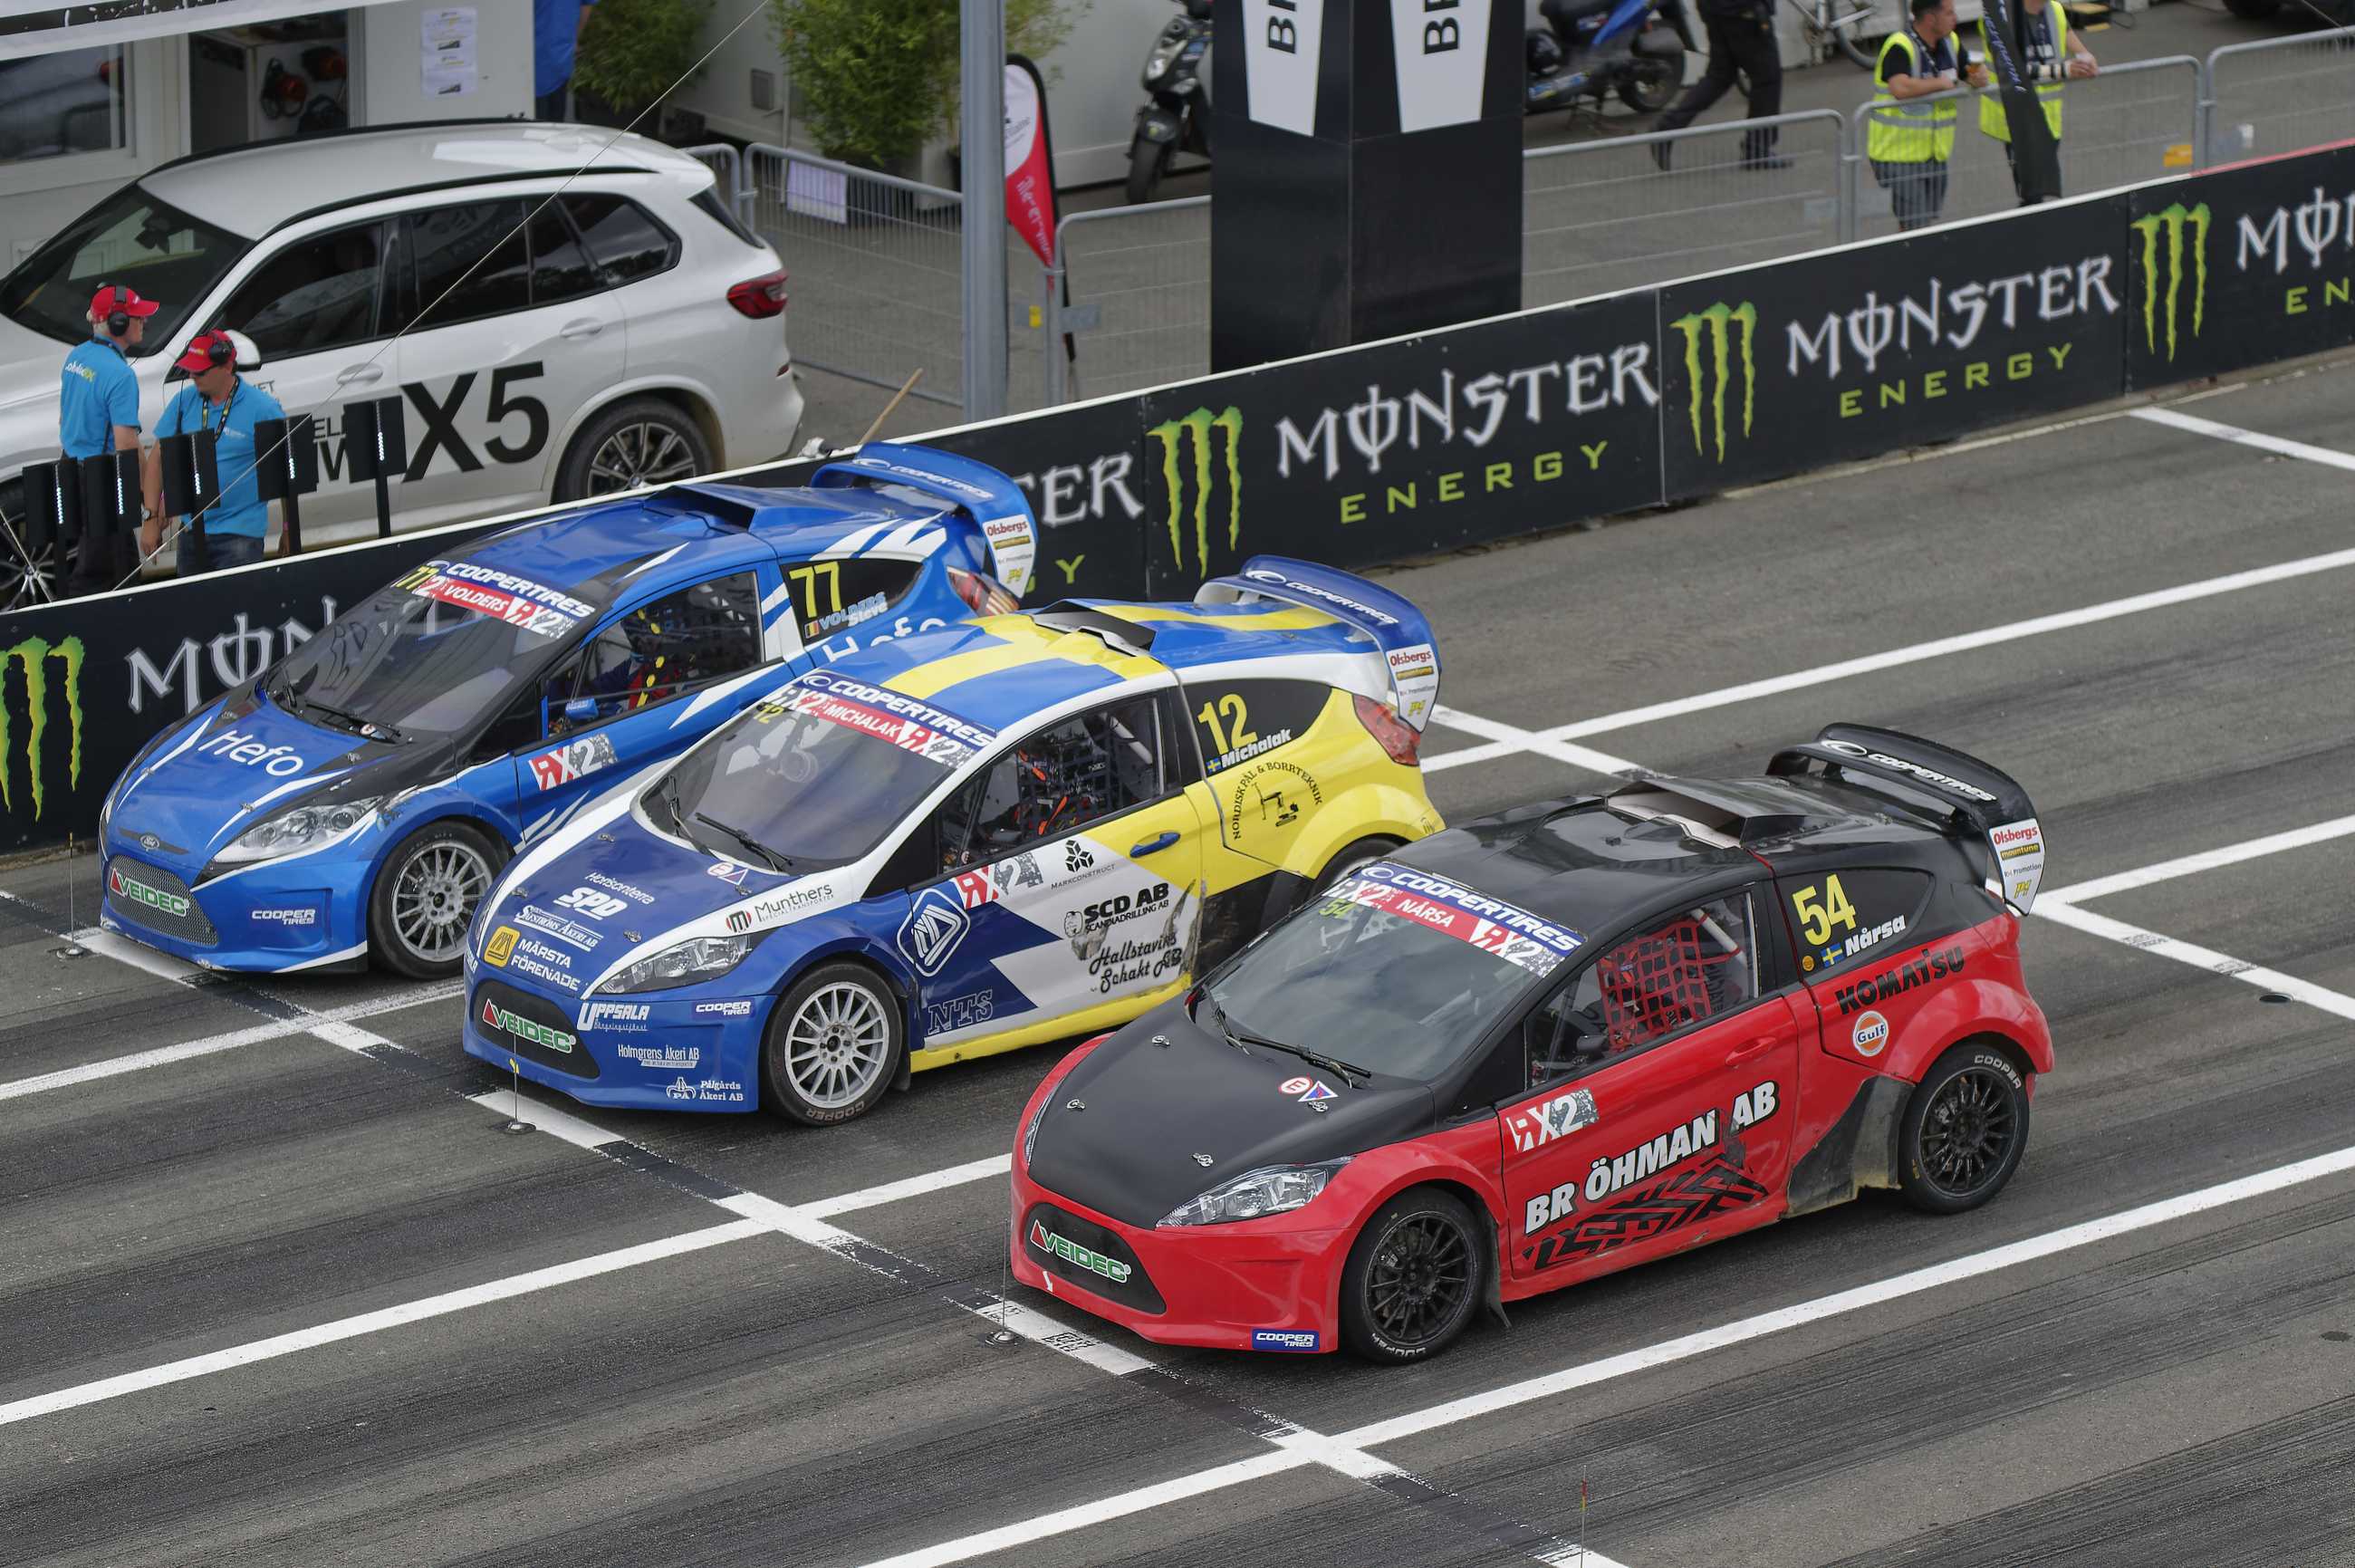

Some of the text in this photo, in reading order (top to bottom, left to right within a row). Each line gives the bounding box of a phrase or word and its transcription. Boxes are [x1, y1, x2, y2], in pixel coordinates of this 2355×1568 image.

[1786, 255, 2120, 380] MONSTER
[1840, 343, 2072, 418] ENERGY
[400, 361, 550, 484] X5
[1275, 341, 1659, 480] MONSTER
[1340, 440, 1608, 524] ENERGY
[987, 520, 1028, 537] Olsbergs
[393, 565, 440, 591] 77
[444, 583, 509, 611] VOLDERS
[789, 561, 842, 618] 77
[1390, 649, 1432, 668] Olsbergs
[825, 703, 902, 739] MICHALAK
[1197, 694, 1258, 755] 12
[197, 730, 303, 776] Hefo
[529, 739, 605, 791] RX2
[1221, 729, 1292, 767] Michalak
[1256, 765, 1264, 774] &
[1266, 761, 1322, 805] BORRTEKNIK
[1994, 825, 2038, 846] Olsbergs
[119, 876, 189, 917] VEIDEC
[558, 887, 629, 918] SPD
[755, 884, 832, 922] Munthers
[949, 858, 1030, 910] RX2
[1085, 882, 1169, 924] SCD AB
[252, 909, 316, 921] COOPER
[283, 917, 315, 926] TIRES
[1156, 900, 1169, 914] AB
[1793, 873, 1856, 946] 54
[518, 938, 572, 969] MÄRSTA
[1845, 914, 1906, 957] Nårsa
[511, 956, 581, 991] FÖRENADE
[1101, 958, 1150, 993] Schakt
[1835, 946, 1965, 1015] KOMATSU
[577, 1002, 650, 1032] UPPSALA
[696, 1001, 752, 1014] COOPER
[722, 1008, 751, 1016] TIRES
[928, 988, 994, 1035] NTS
[492, 1004, 572, 1054] VEIDEC
[1857, 1024, 1886, 1044] Gulf
[617, 1044, 700, 1062] Holmgrens Åkeri AB
[1975, 1054, 2023, 1090] COOPER
[699, 1090, 744, 1101] Åkeri AB
[1505, 1092, 1591, 1153] RX2
[1525, 1080, 1780, 1236] BR ÖHMAN AB
[1043, 1231, 1127, 1284] VEIDEC
[1255, 1332, 1315, 1342] COOPER
[1283, 1339, 1313, 1348] TIRES
